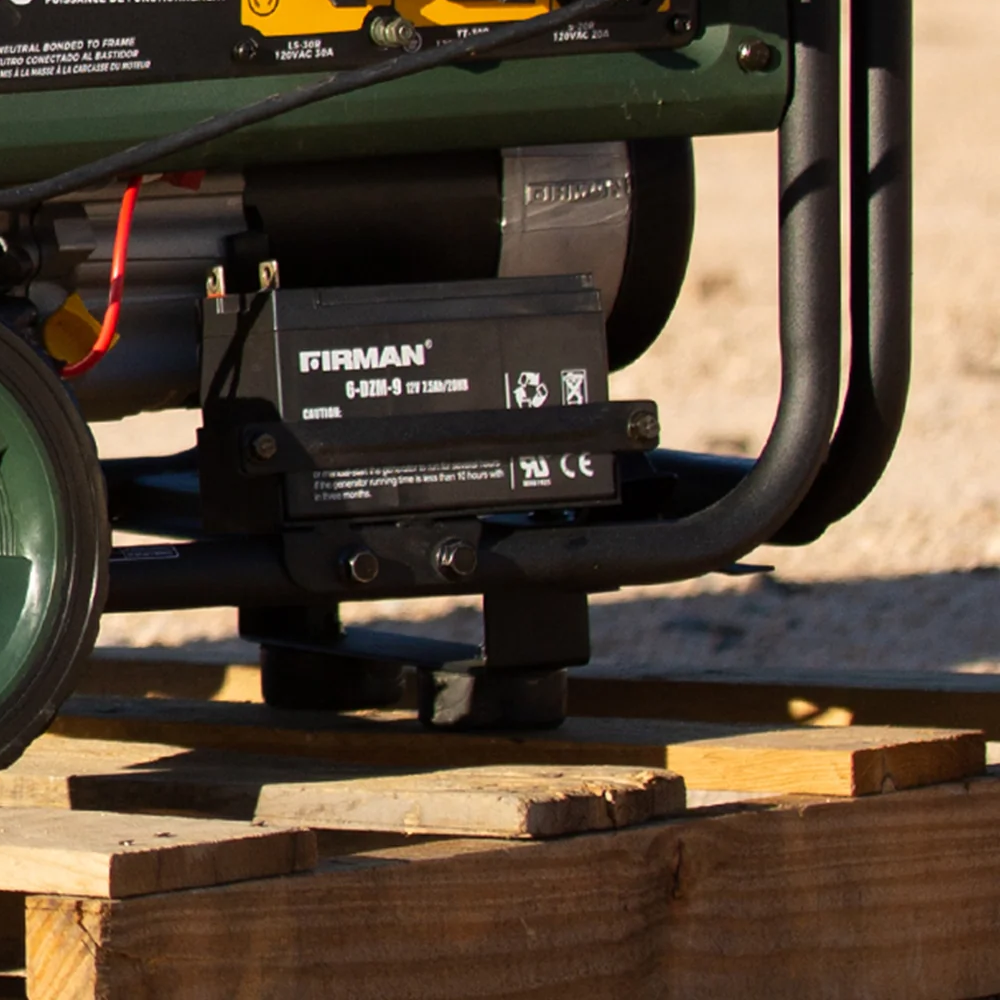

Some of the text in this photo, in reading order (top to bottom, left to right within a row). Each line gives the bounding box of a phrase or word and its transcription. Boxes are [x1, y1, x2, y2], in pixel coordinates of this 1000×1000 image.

[43, 40, 84, 52] BONDED
[87, 39, 100, 49] TO
[102, 37, 136, 47] FRAME
[26, 54, 80, 66] CONECTADO
[82, 52, 93, 61] AL
[299, 344, 426, 373] FIRMAN
[405, 381, 420, 395] 12V
[302, 406, 342, 420] CAUTION:
[369, 477, 398, 488] running
[398, 475, 414, 485] time
[466, 470, 488, 480] hours
